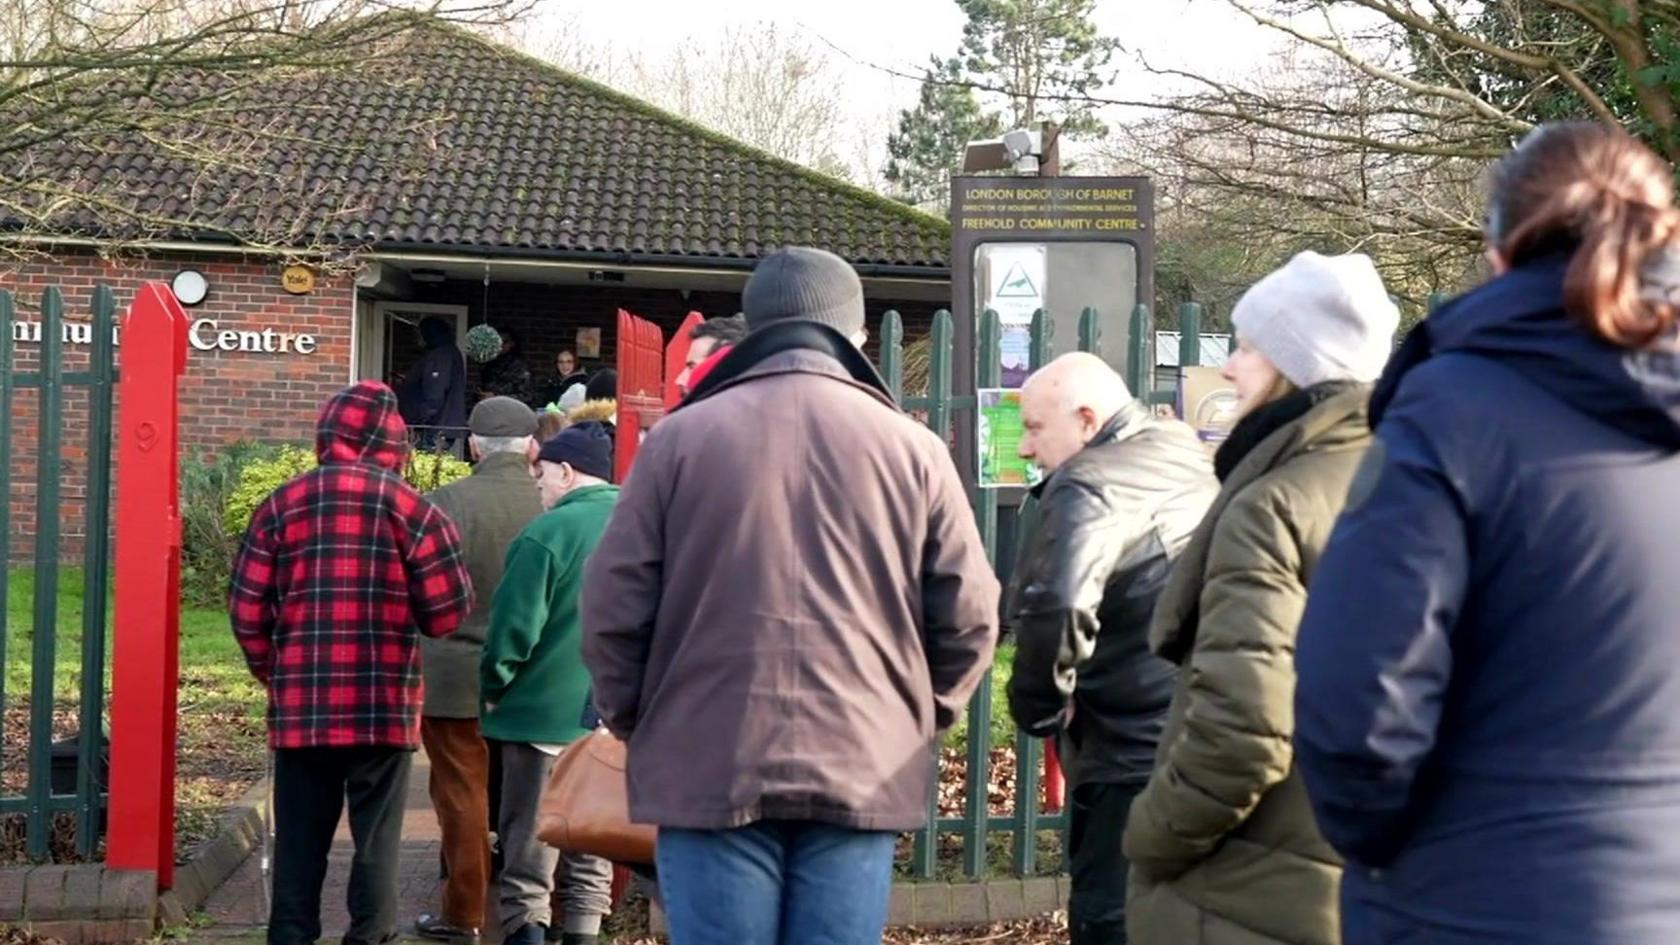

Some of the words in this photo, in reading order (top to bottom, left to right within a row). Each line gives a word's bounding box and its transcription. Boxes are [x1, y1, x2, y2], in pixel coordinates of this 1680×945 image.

[965, 188, 1014, 200] LONDON
[1075, 188, 1092, 200] OF
[1092, 188, 1134, 200] BARNET
[962, 218, 1015, 230] FREEHOLD
[1019, 218, 1093, 230] COMMUNITY
[1095, 218, 1138, 230] CENTRE
[188, 318, 316, 354] Centre
